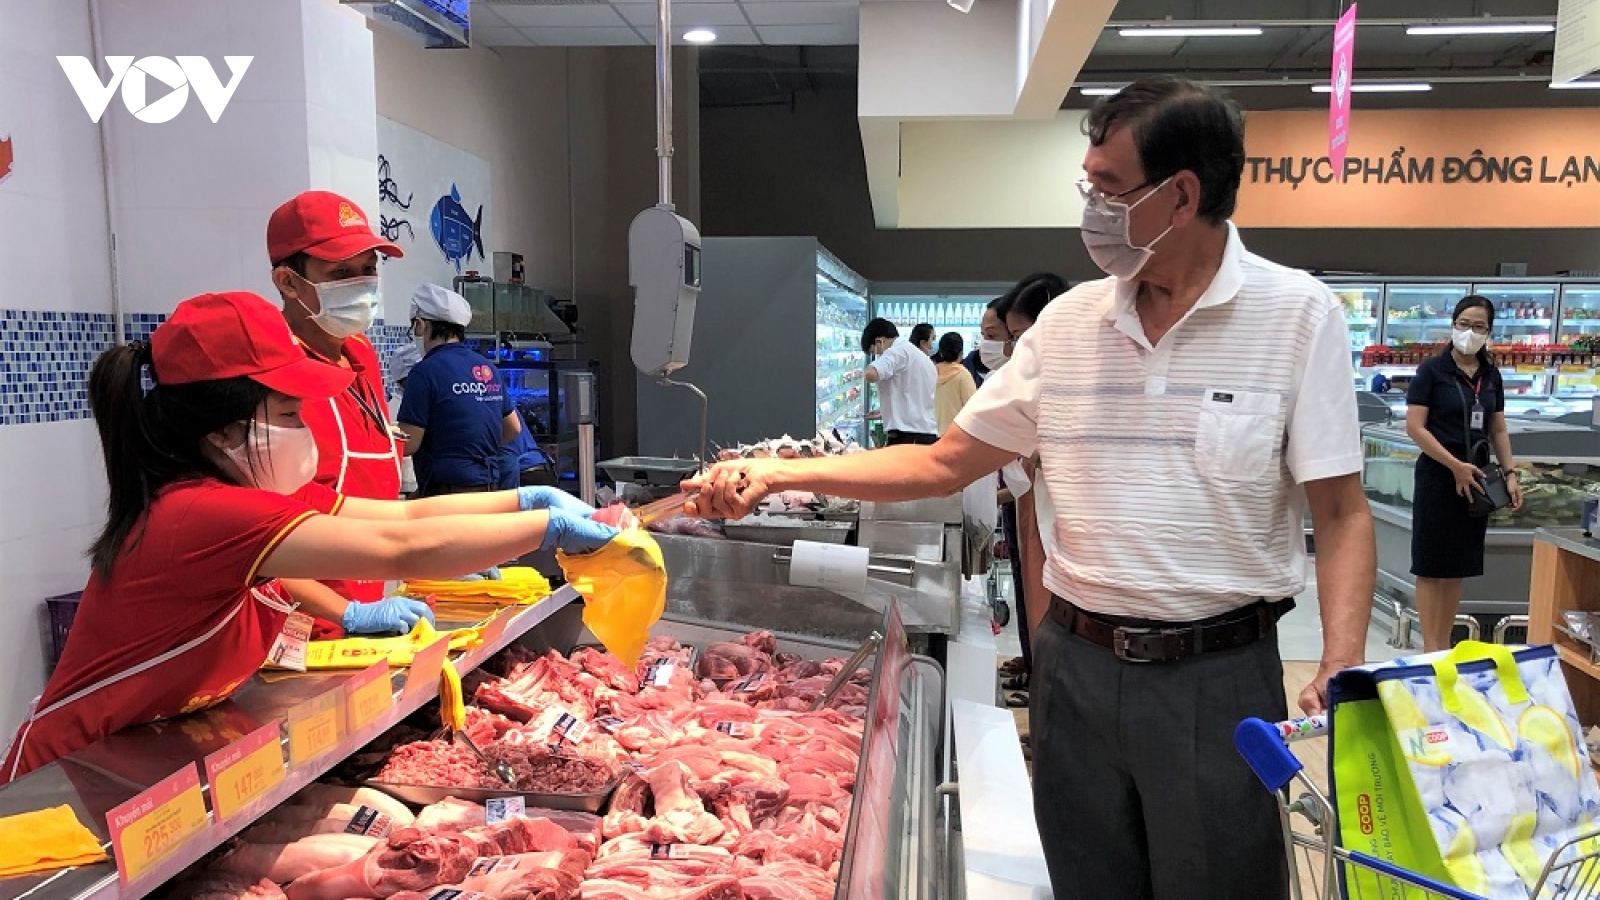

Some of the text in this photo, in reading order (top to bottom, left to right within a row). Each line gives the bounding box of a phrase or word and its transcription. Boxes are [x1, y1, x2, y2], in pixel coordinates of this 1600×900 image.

[1246, 156, 1334, 191] THỰC
[1341, 146, 1434, 184] PHẨM
[1441, 149, 1532, 184] ĐÔNG
[1360, 796, 1372, 834] COOP
[143, 825, 169, 859] 225
